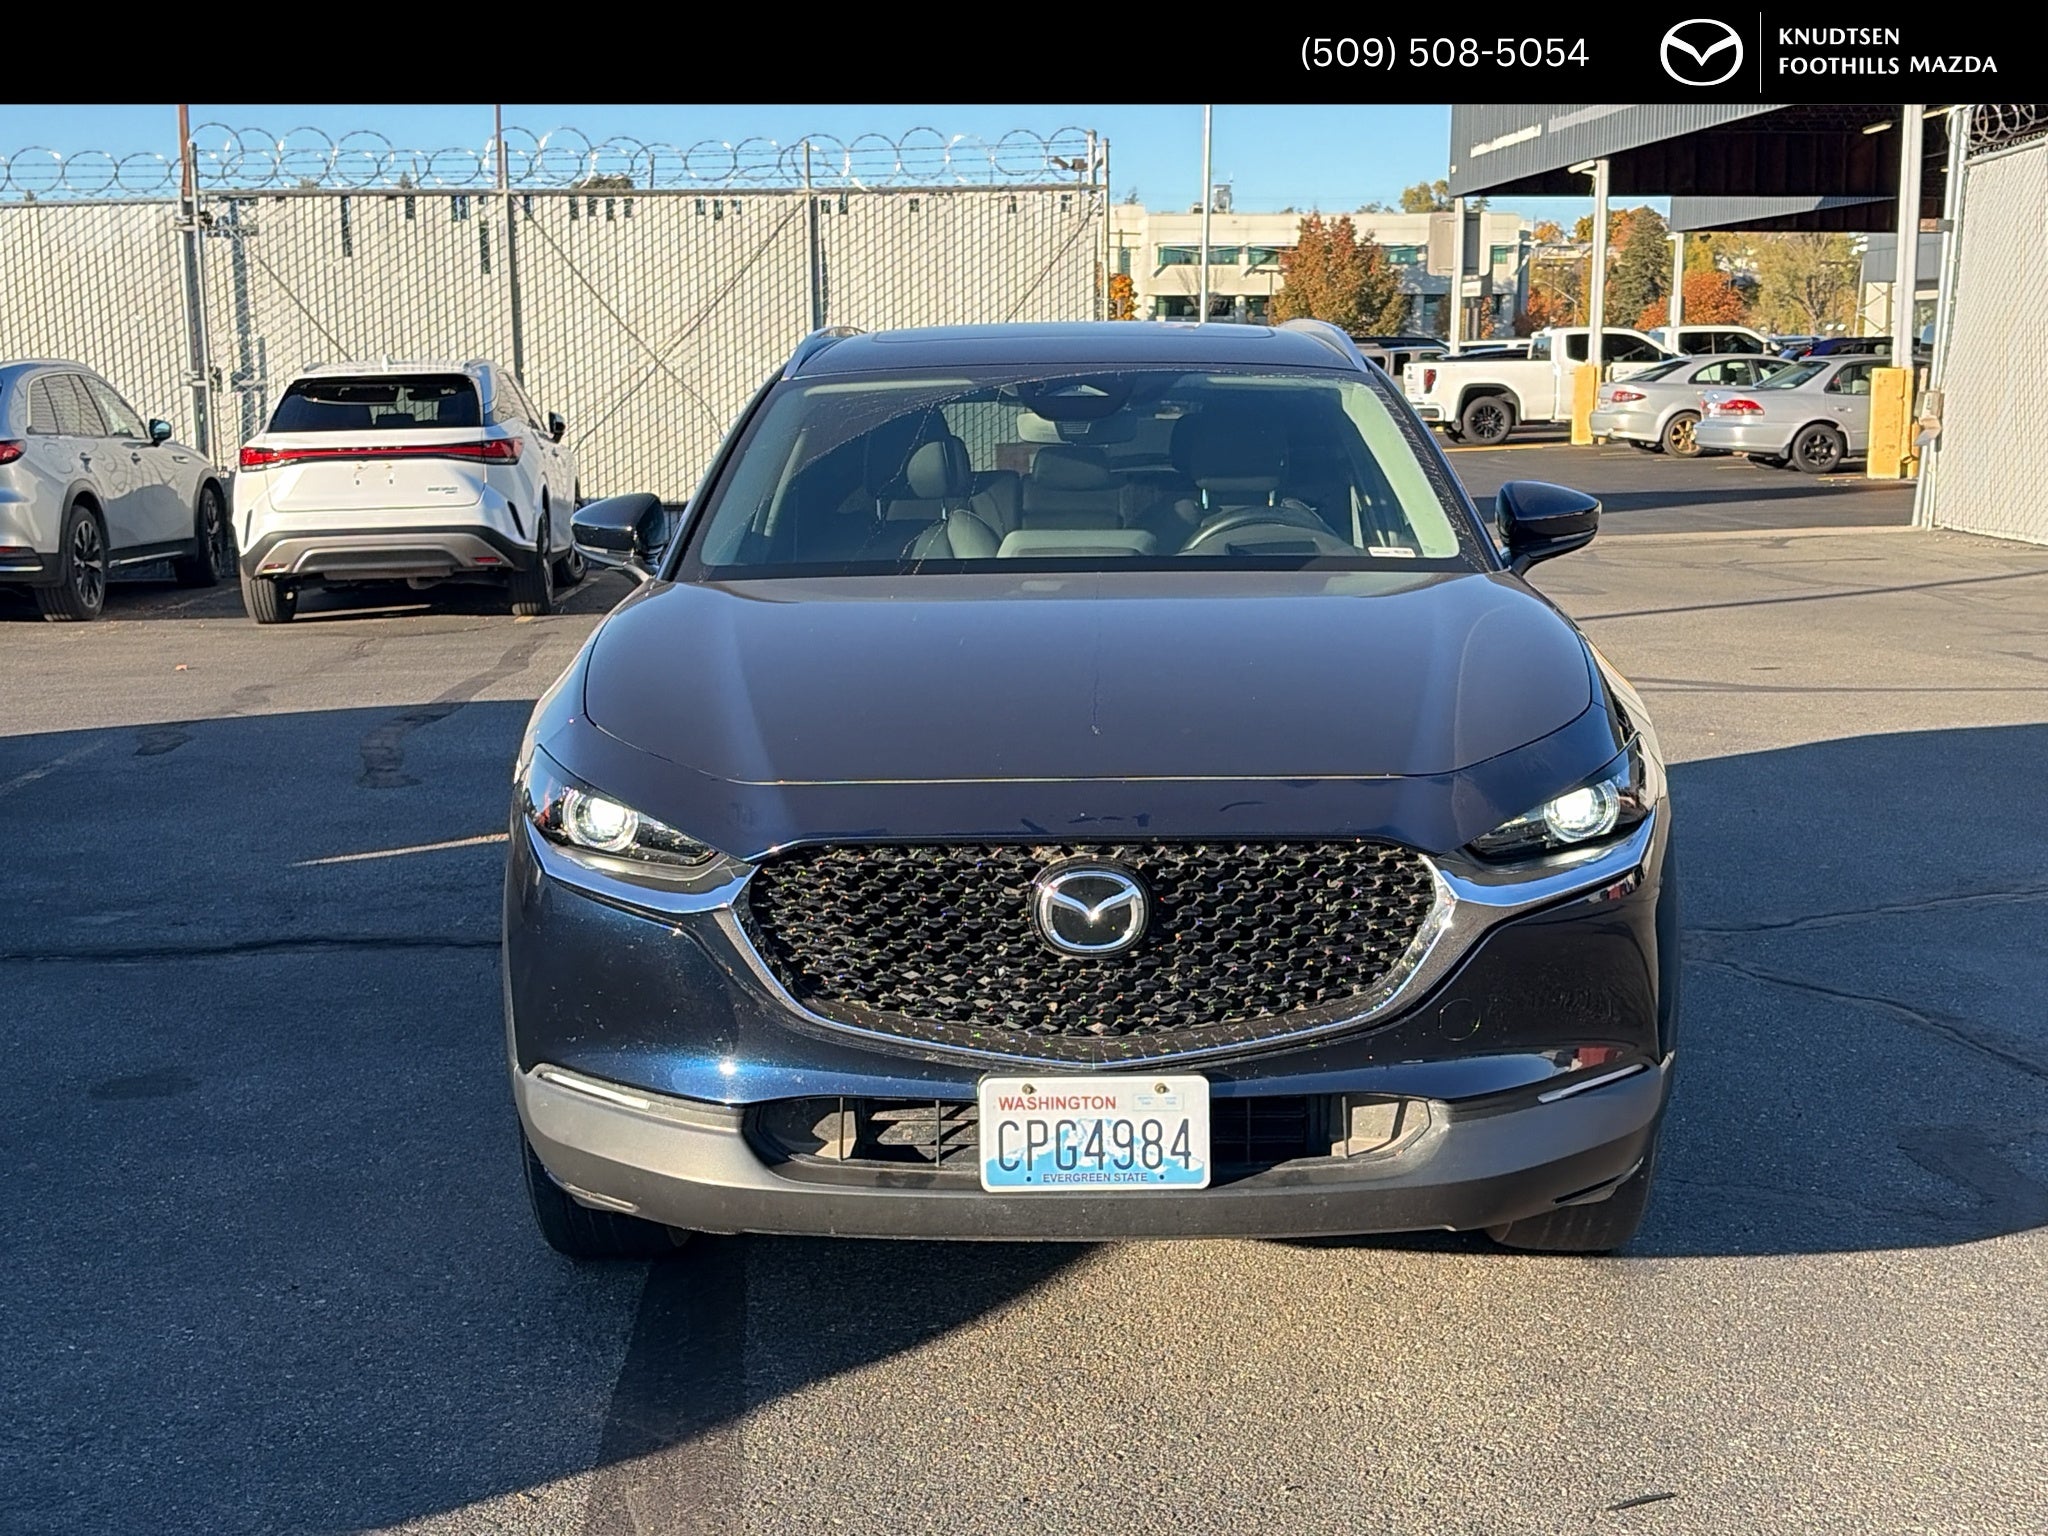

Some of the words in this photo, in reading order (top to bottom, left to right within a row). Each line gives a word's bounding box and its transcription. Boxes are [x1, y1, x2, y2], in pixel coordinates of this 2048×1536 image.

[999, 1096, 1116, 1111] WASHINGTON
[998, 1119, 1191, 1171] CPG4984
[1043, 1173, 1111, 1183] EVERGREEN
[1114, 1172, 1148, 1182] STATE
